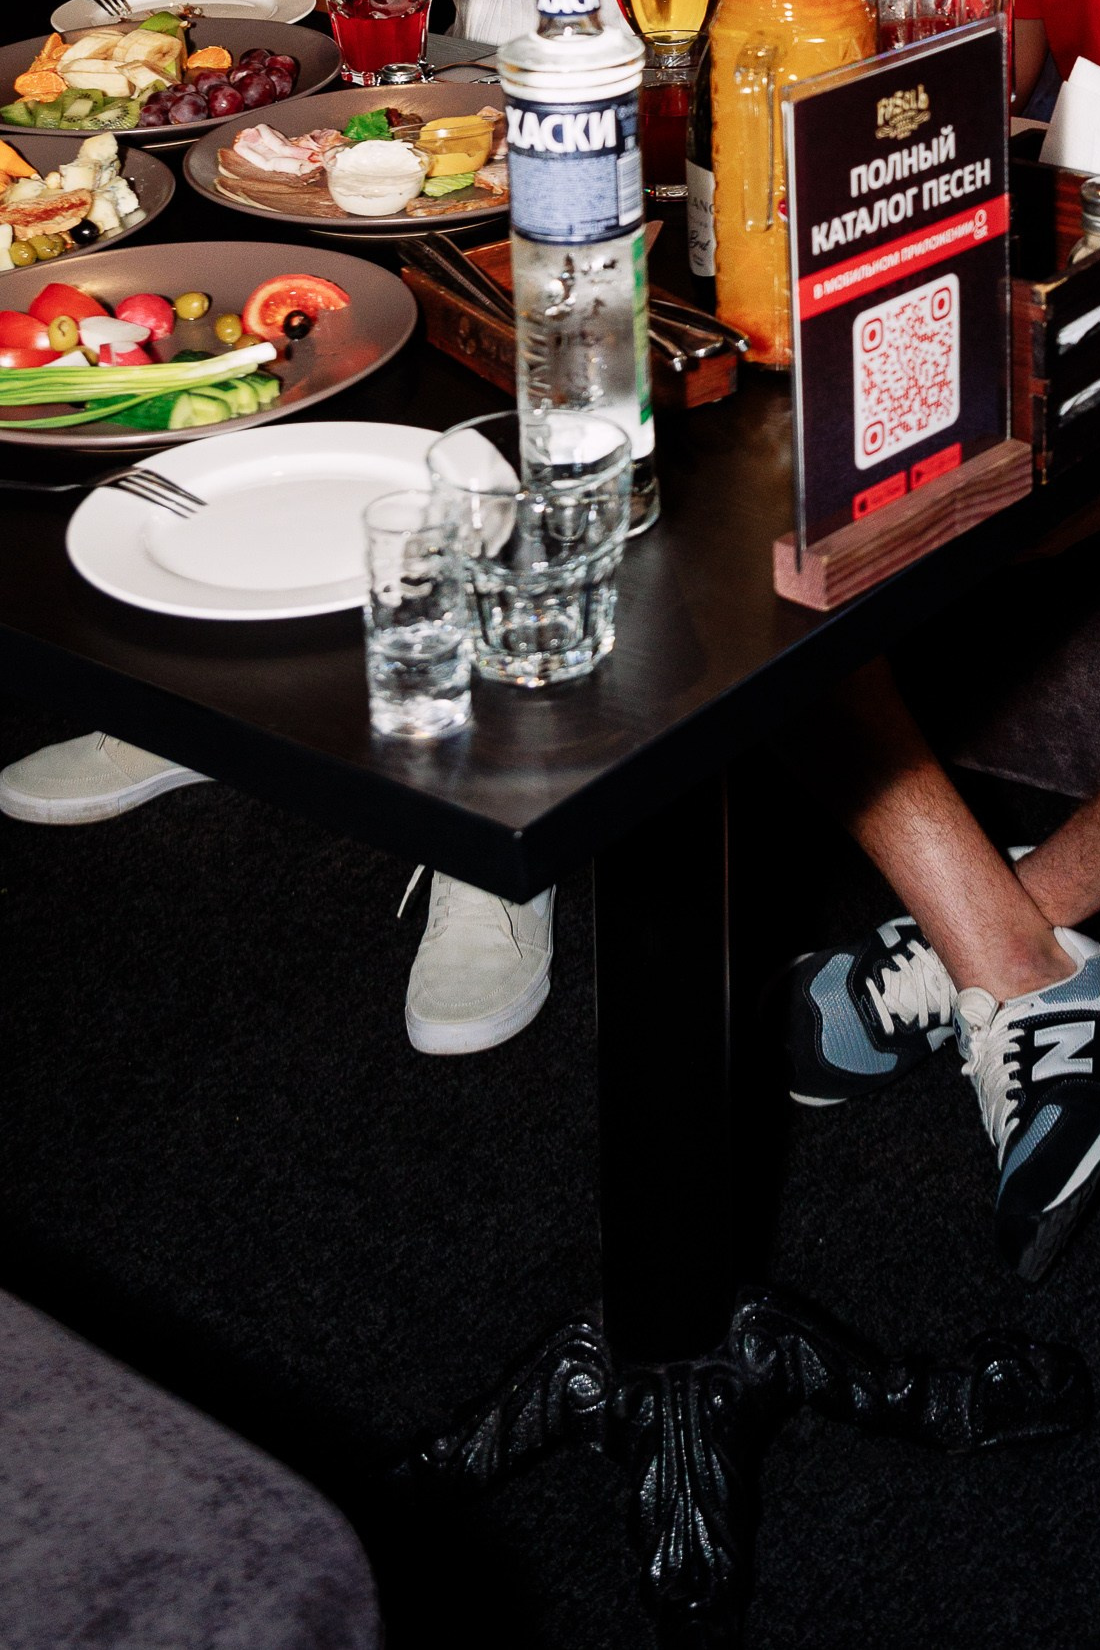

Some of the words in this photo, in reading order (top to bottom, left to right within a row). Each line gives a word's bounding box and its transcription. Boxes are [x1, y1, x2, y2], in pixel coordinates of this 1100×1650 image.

[505, 105, 617, 154] ХАСКИ
[850, 124, 956, 198] ПОЛНЫЙ
[811, 185, 918, 256] КАТАЛОГ
[922, 157, 991, 212] ПЕСЕН
[1031, 1020, 1096, 1082] N
